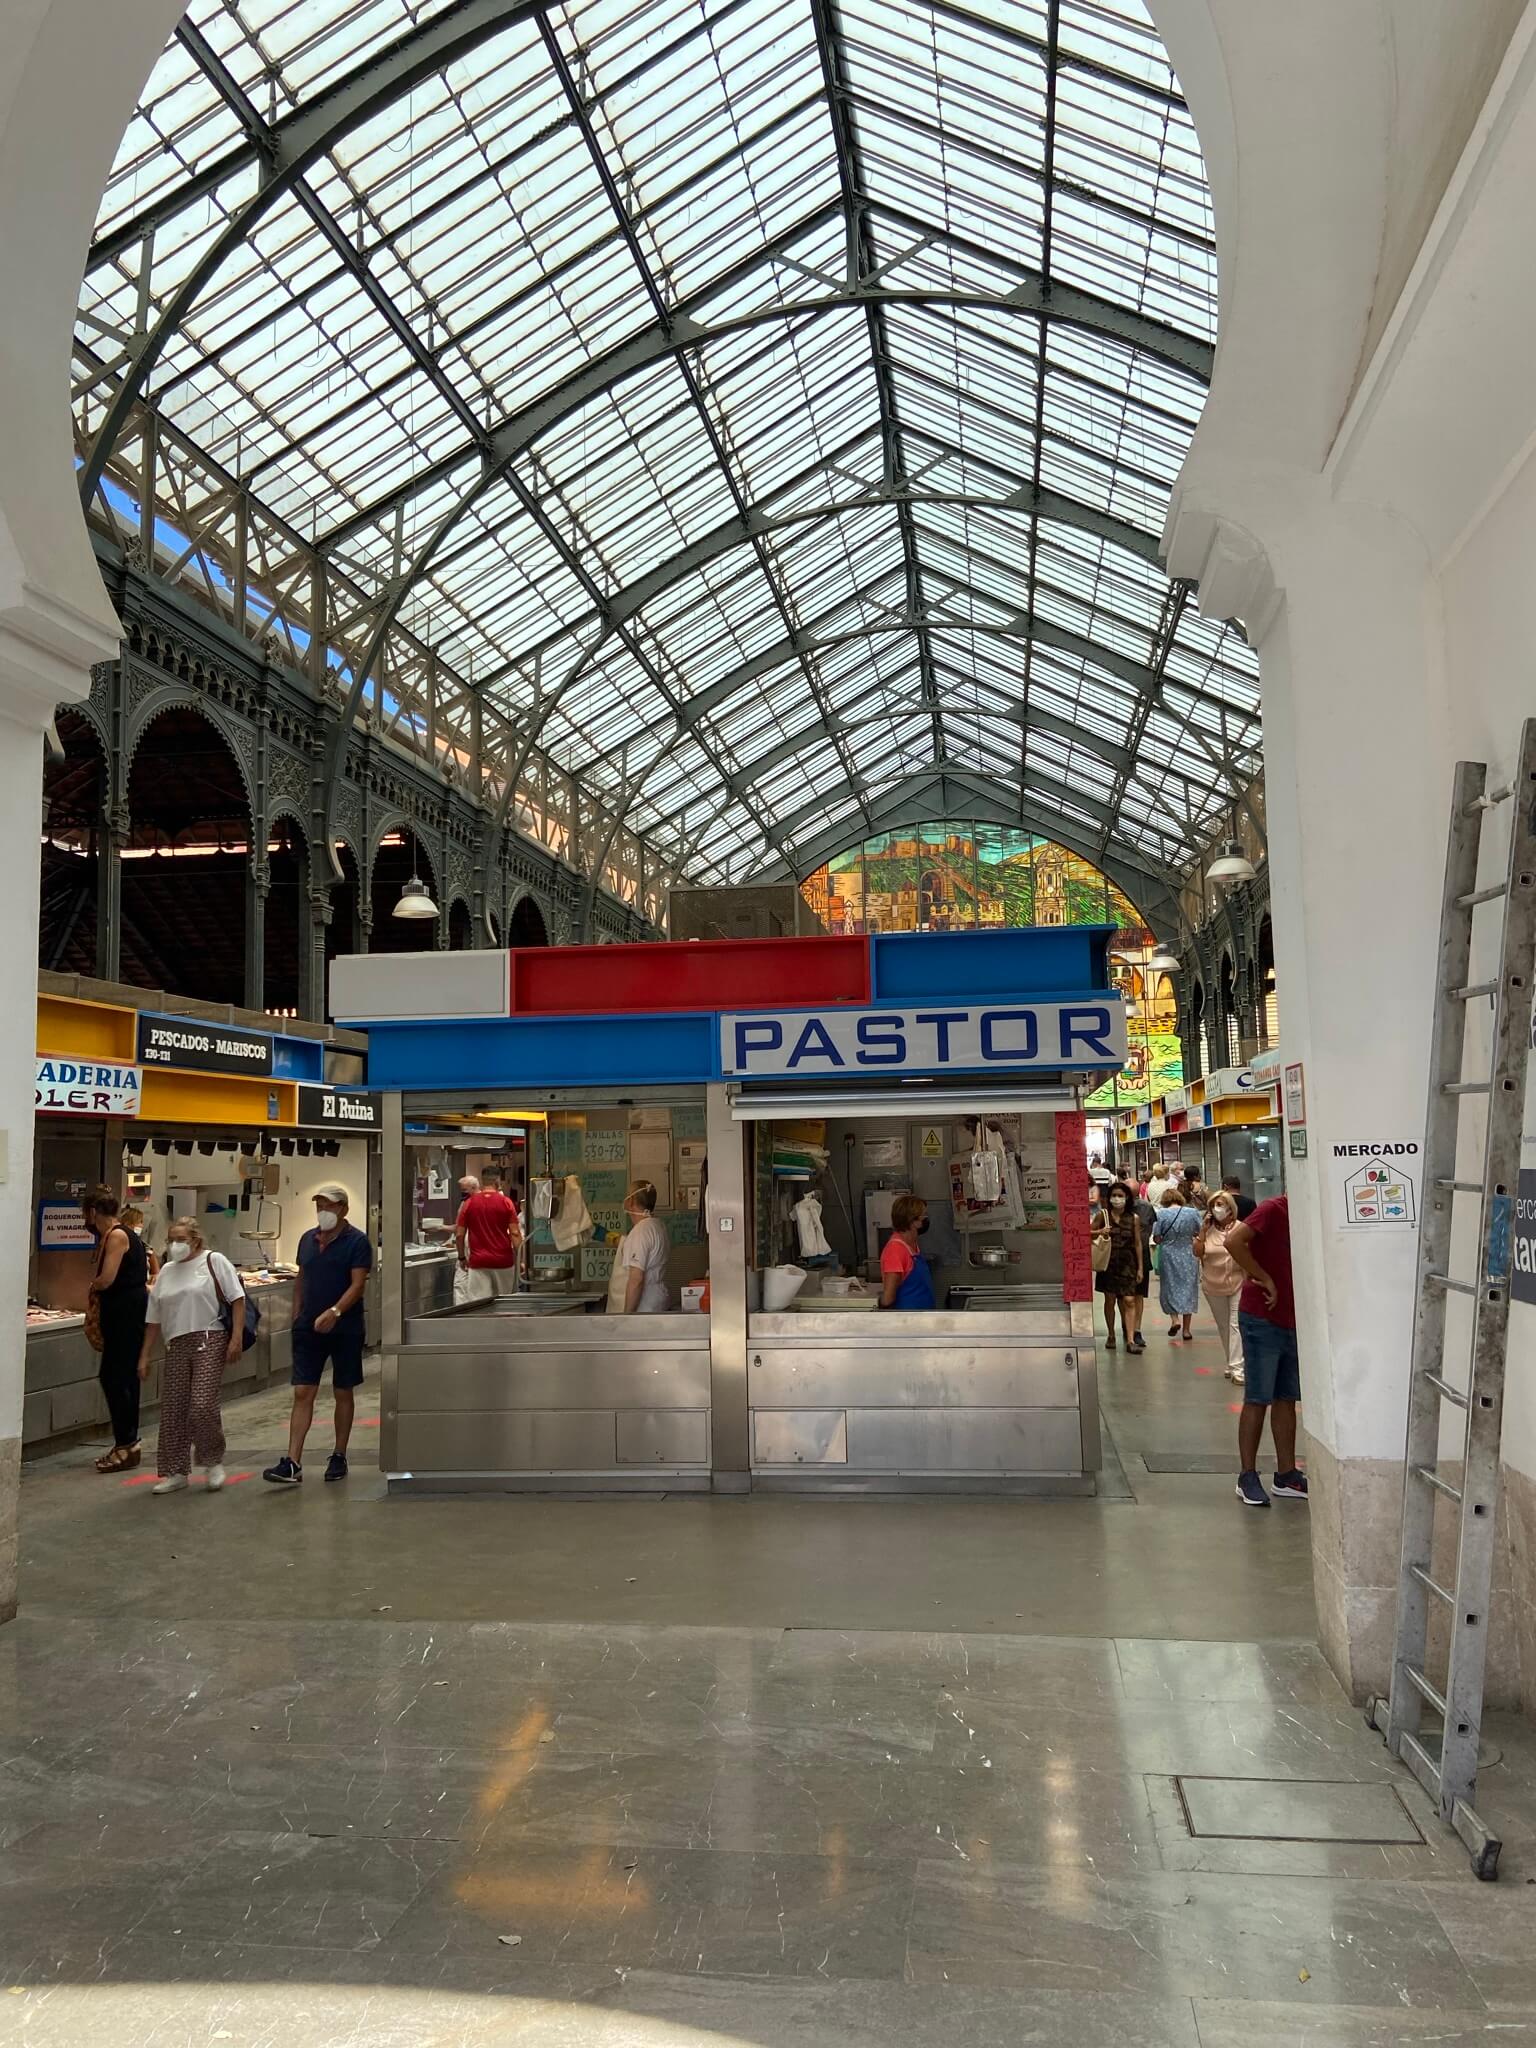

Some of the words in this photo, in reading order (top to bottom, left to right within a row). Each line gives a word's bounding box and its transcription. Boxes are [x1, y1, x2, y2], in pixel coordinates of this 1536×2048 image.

[151, 1029, 209, 1052] PESCADOS
[216, 1039, 266, 1060] MARISCOS
[735, 1006, 1117, 1070] PASTOR
[145, 1048, 171, 1062] 130-131
[36, 1062, 138, 1090] ADERIA
[322, 1095, 335, 1117] El
[339, 1097, 374, 1121] Ruina
[585, 1130, 624, 1139] ANILLAS
[1333, 1143, 1418, 1157] MERCADO
